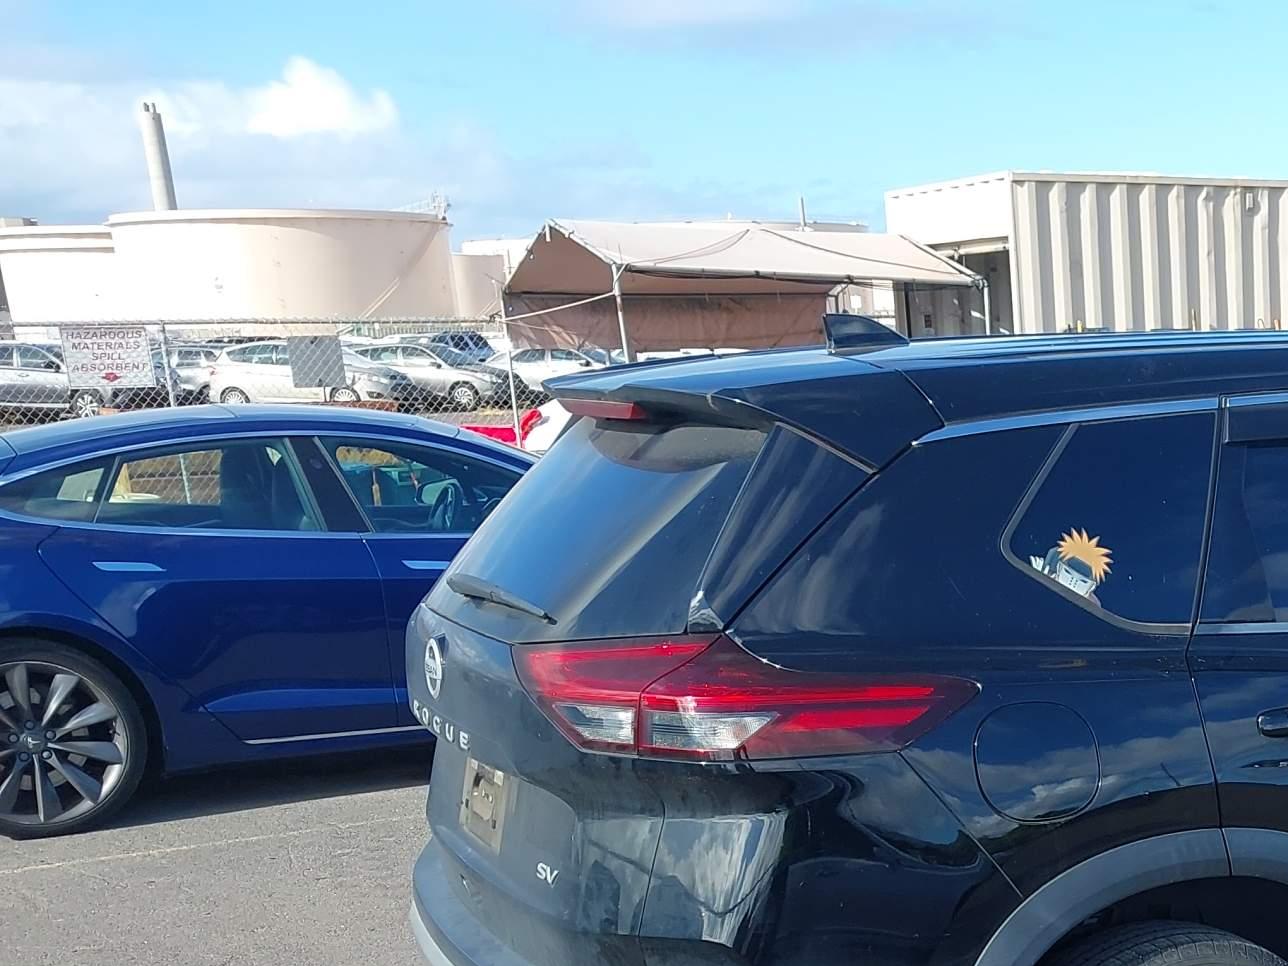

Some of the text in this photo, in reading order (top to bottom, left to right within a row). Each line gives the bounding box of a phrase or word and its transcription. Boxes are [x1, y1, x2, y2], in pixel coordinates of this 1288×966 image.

[66, 330, 142, 340] HAZARDOUS
[71, 341, 141, 351] MATERIALS
[91, 352, 125, 361] SPILL
[413, 700, 470, 750] ROGUE
[536, 862, 559, 888] SV
